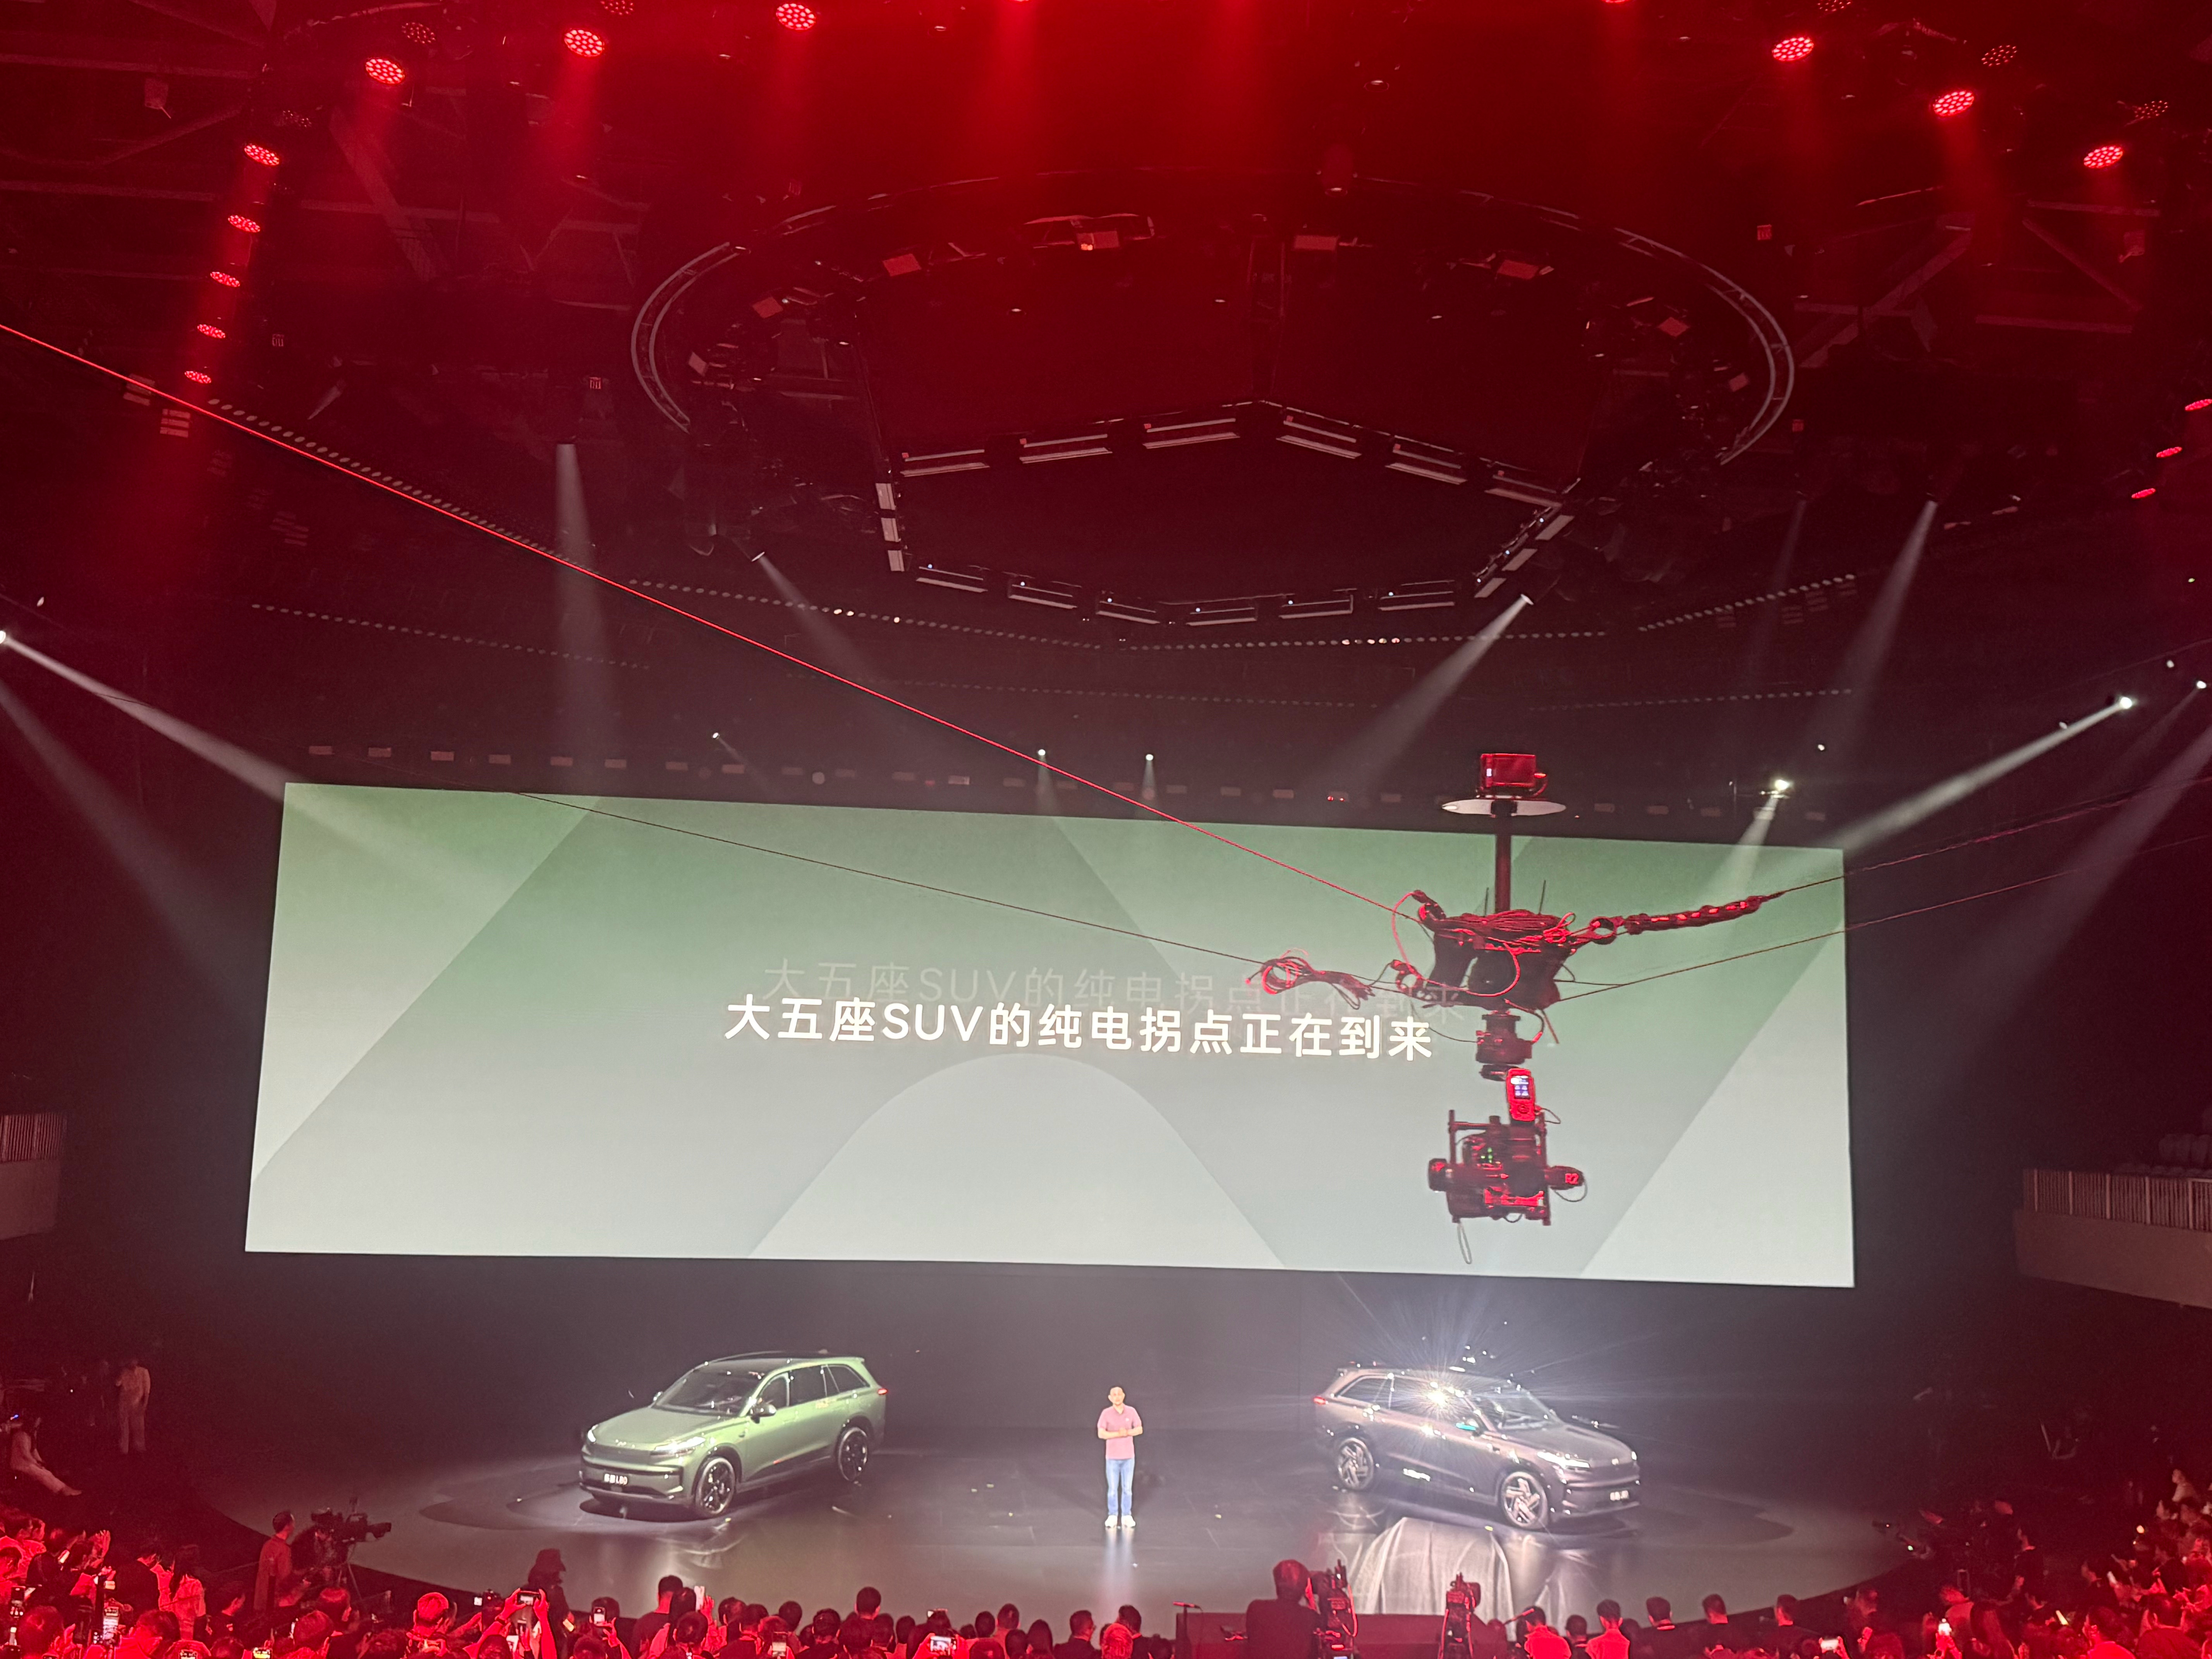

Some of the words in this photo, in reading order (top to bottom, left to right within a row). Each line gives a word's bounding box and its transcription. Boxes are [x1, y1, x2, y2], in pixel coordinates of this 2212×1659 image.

[725, 993, 1432, 1061] 大五座SUV的纯电拐点正在到来
